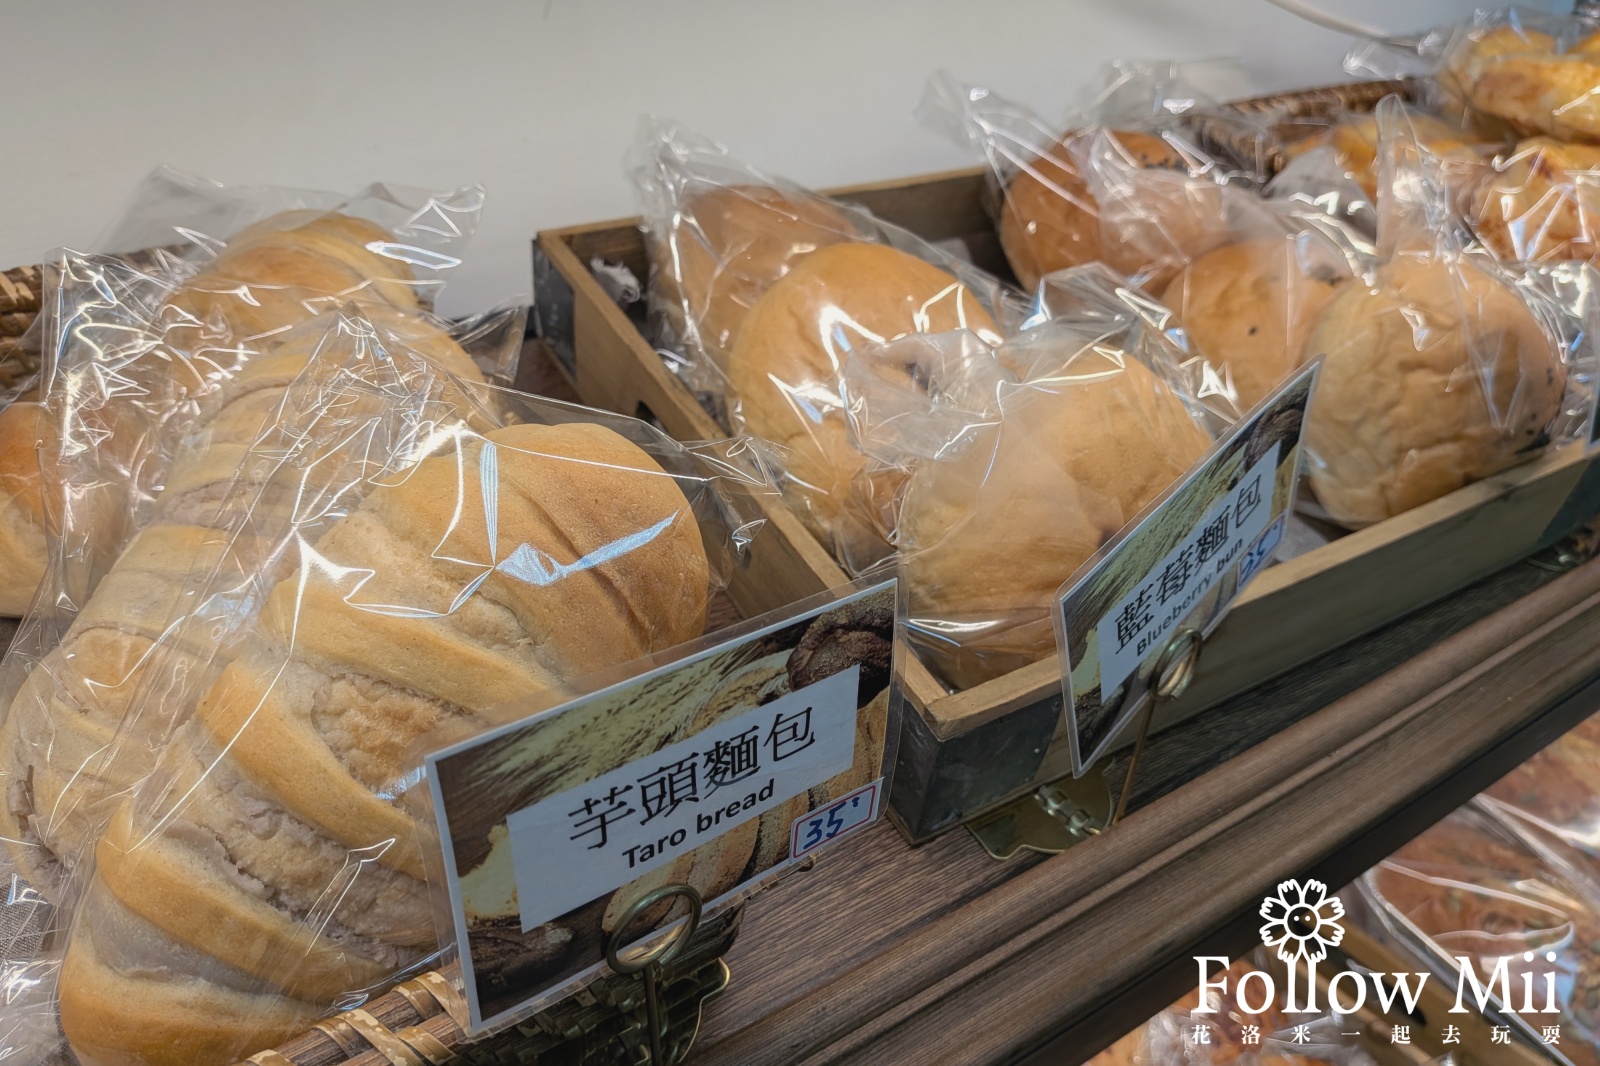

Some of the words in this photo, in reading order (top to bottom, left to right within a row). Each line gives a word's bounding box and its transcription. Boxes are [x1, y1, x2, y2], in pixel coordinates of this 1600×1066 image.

[1114, 474, 1262, 655] 藍莓麵包
[1137, 575, 1211, 656] Blueberry
[1217, 539, 1243, 572] bun
[567, 706, 815, 850] 芋頭麵包
[622, 827, 687, 869] Taro
[696, 778, 775, 834] bread
